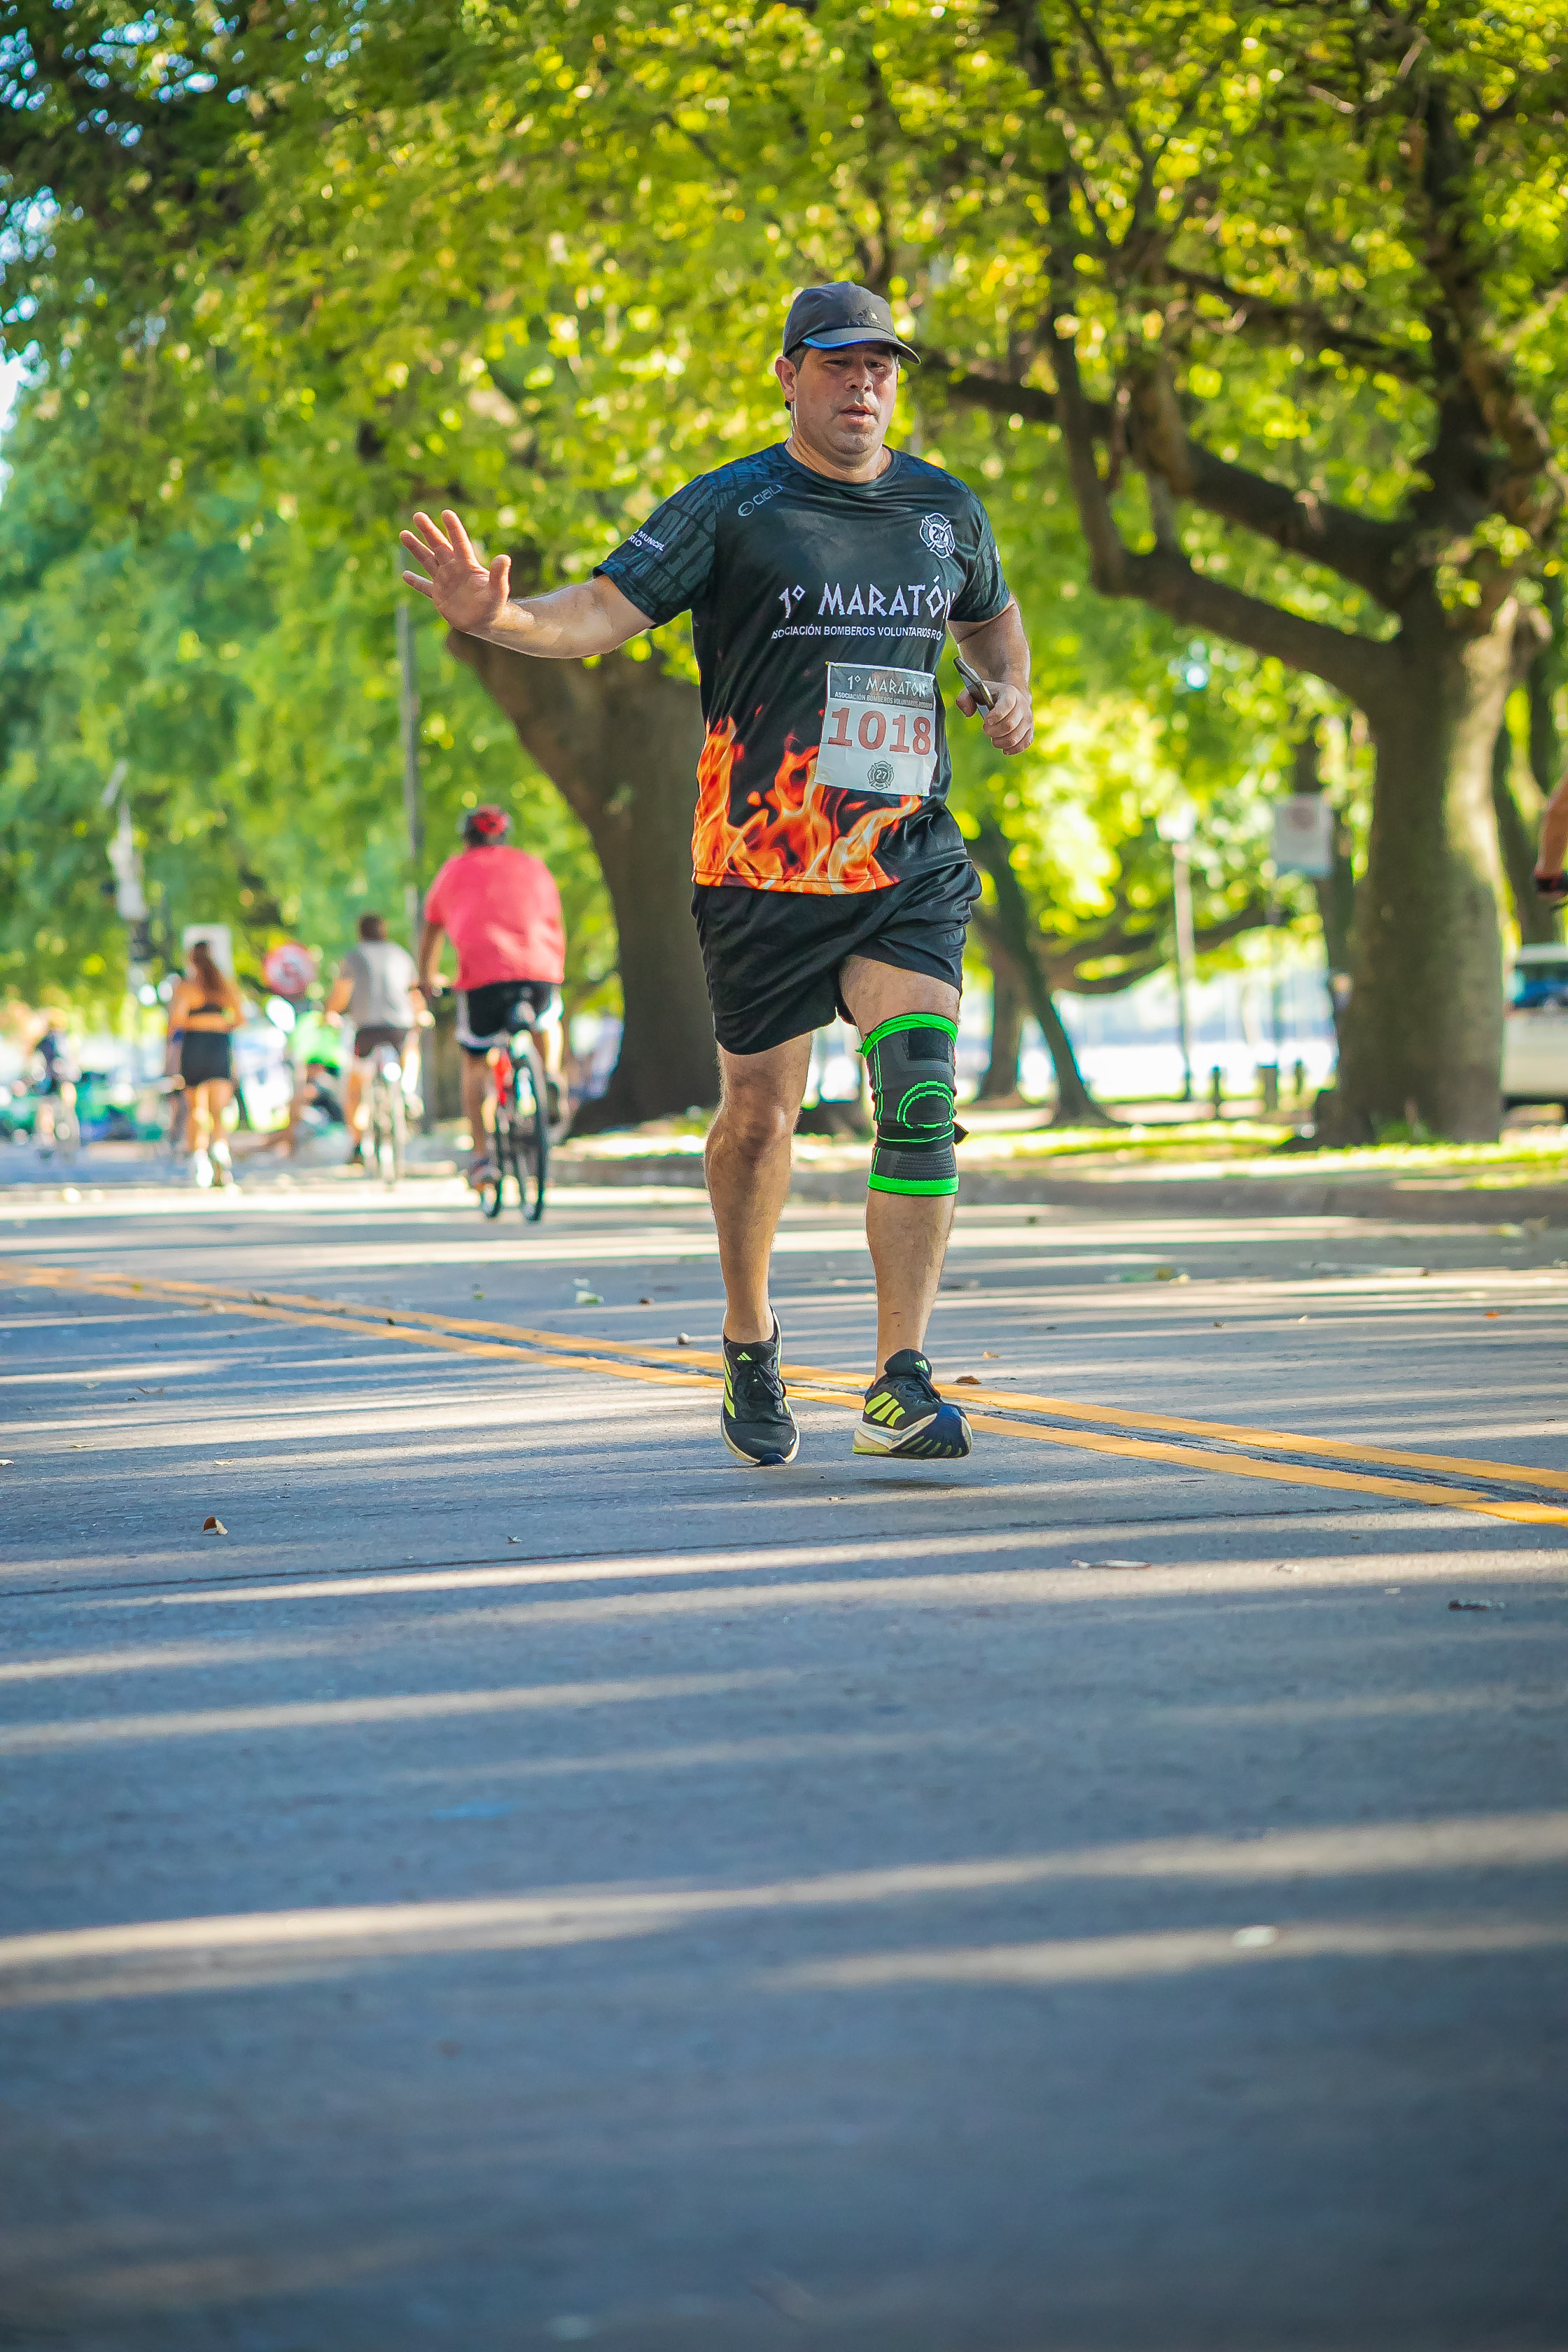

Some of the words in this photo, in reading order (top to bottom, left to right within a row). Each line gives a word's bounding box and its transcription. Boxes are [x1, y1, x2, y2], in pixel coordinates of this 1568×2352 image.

[824, 626, 875, 636] BOMBEROS
[878, 626, 930, 638] VOLUNTARIOS
[865, 677, 925, 698] MARATÓN
[834, 691, 866, 700] ASOCIACIÓN
[866, 694, 893, 704] BOMBEROS
[827, 707, 931, 755] 1018
[876, 769, 888, 780] 27
